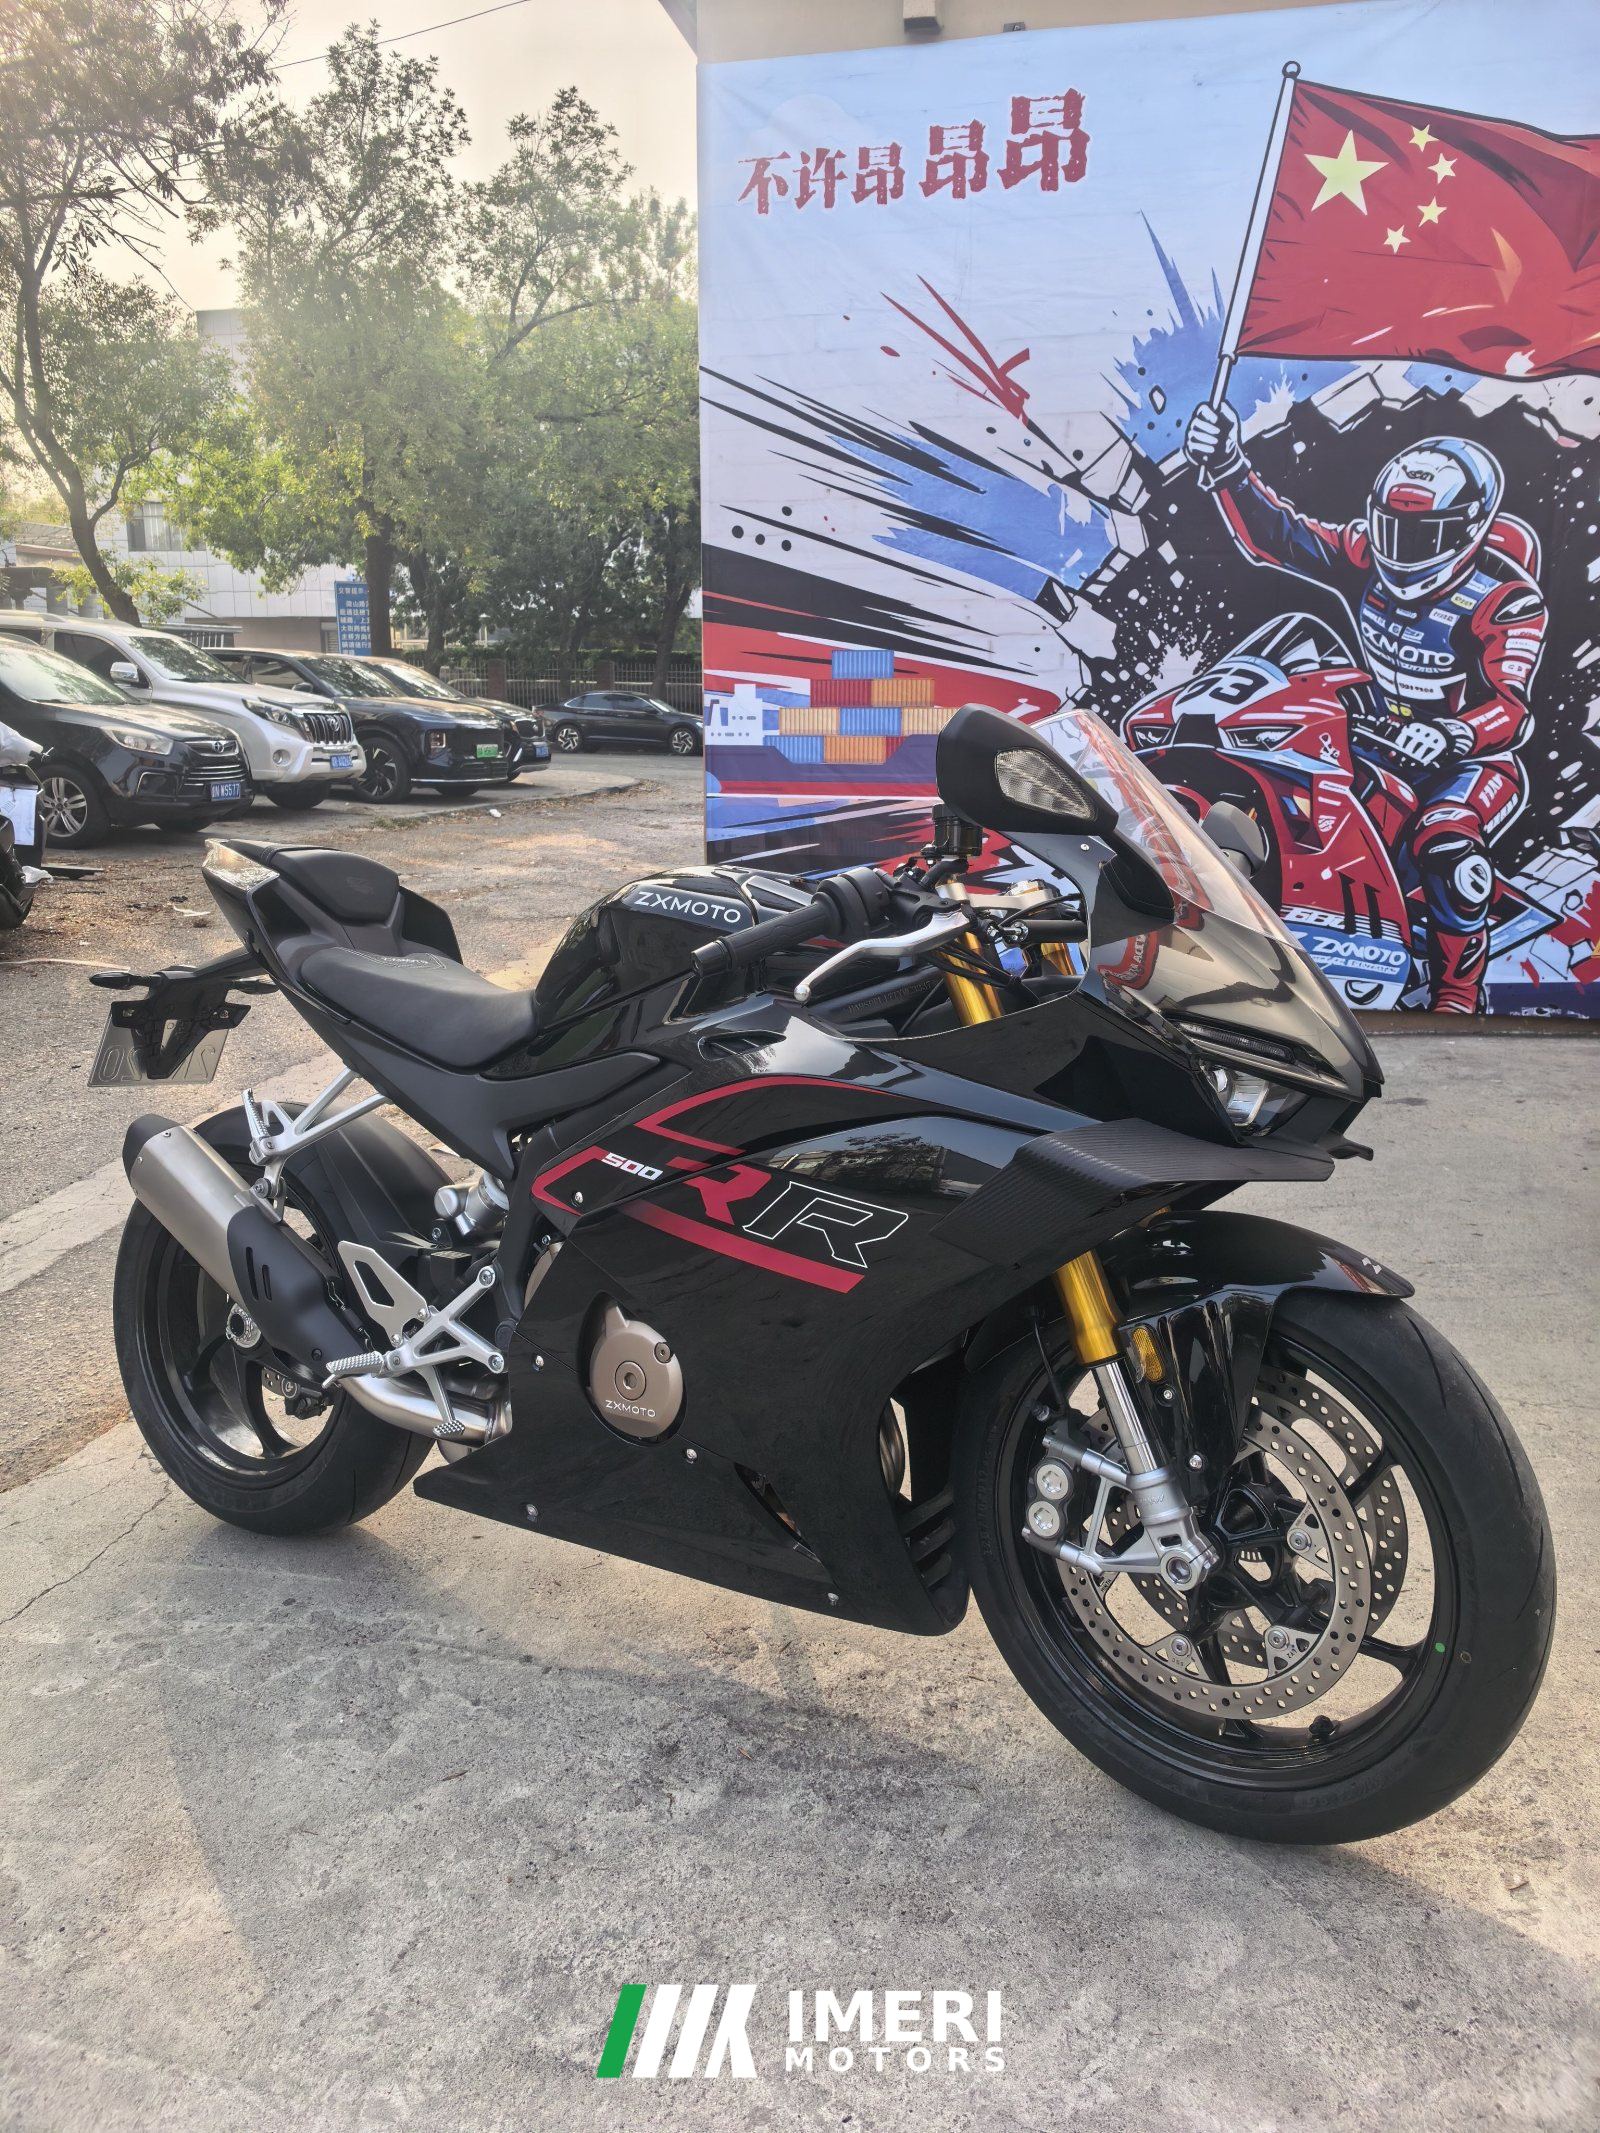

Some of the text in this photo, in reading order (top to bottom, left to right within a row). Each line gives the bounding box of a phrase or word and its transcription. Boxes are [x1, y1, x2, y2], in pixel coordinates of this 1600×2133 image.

[634, 890, 742, 924] ZXMOTO
[600, 1151, 664, 1181] 500
[604, 1399, 657, 1418] ZXMOTO
